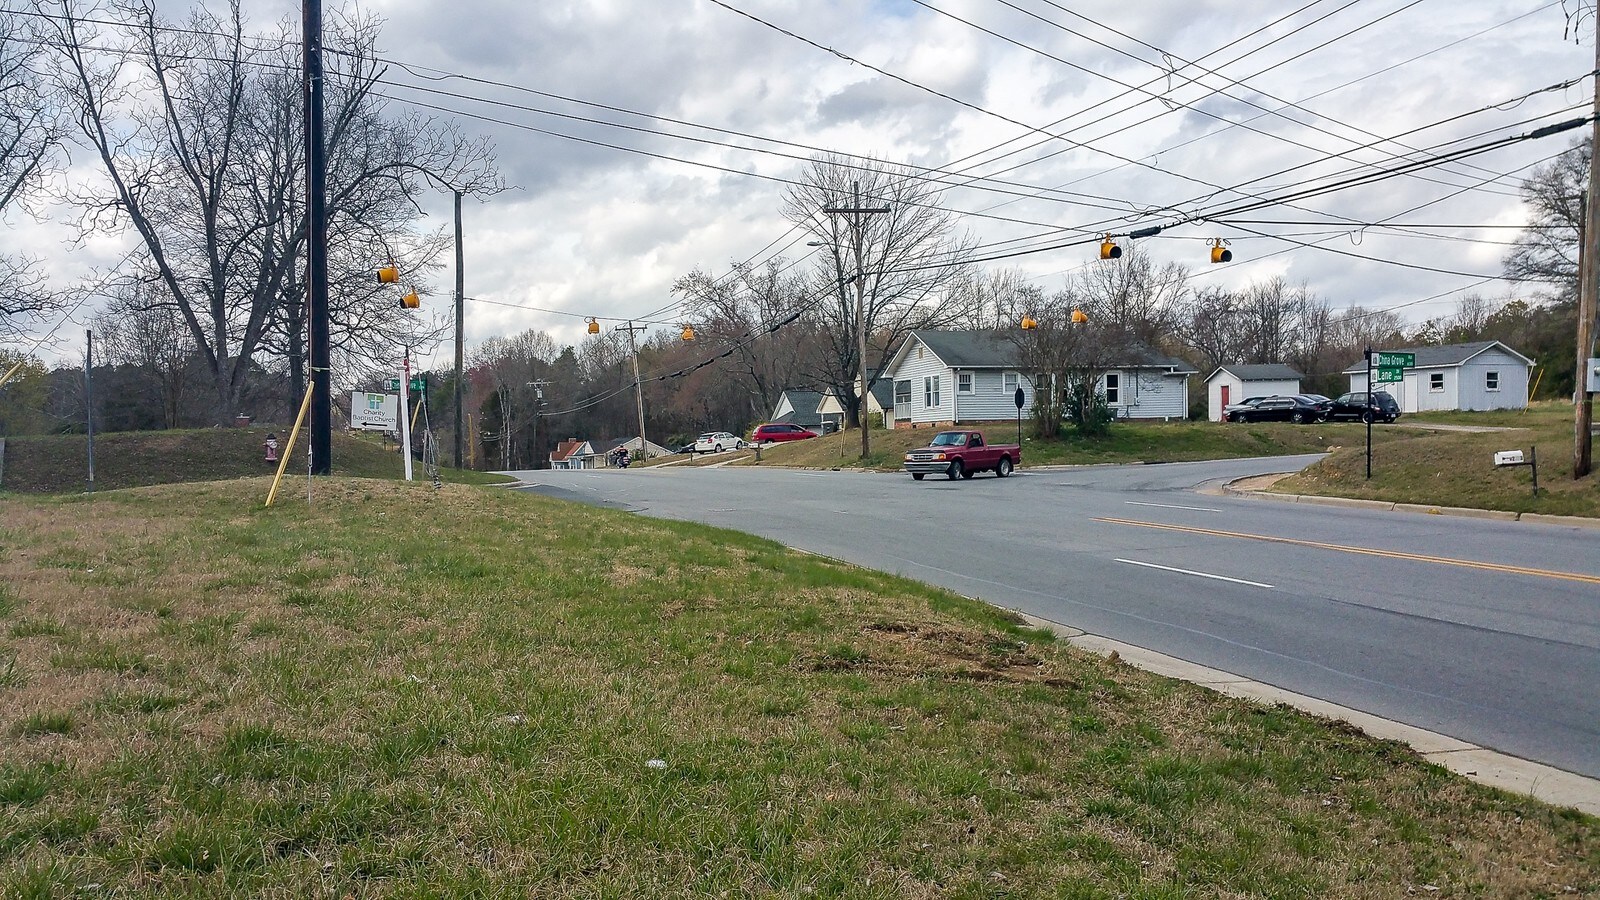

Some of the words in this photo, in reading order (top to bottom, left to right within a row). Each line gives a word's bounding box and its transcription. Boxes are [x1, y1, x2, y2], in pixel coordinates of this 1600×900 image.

[1379, 355, 1390, 365] China
[1391, 355, 1404, 365] Grove
[1378, 370, 1392, 380] Lane
